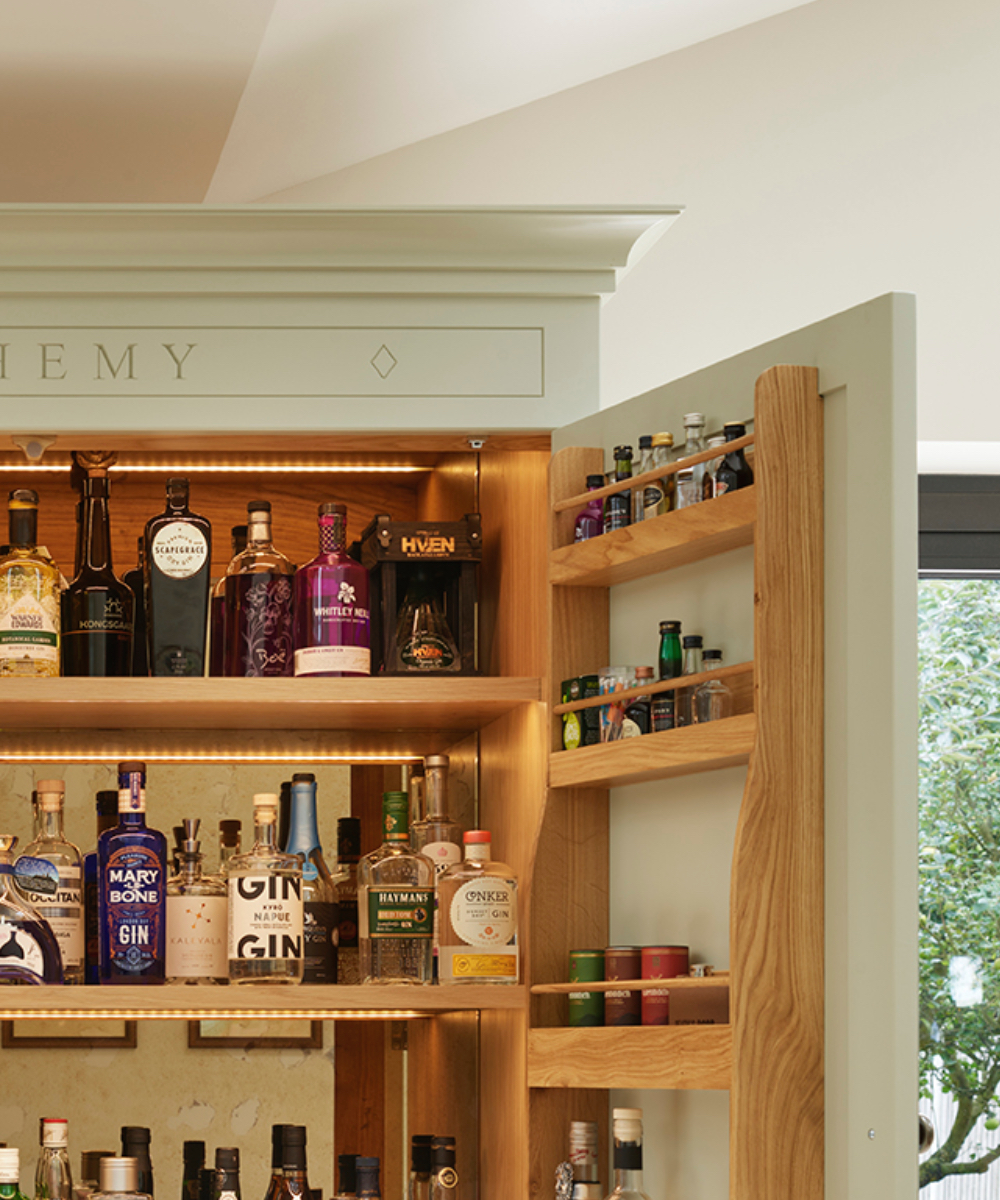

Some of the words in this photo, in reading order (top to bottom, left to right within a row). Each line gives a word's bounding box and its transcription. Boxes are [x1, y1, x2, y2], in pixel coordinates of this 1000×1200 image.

[155, 546, 204, 554] SCAPEGRACE
[314, 606, 352, 617] WHITLEY
[109, 869, 159, 884] MARY
[237, 876, 302, 901] GIN
[110, 890, 158, 903] BONE
[465, 890, 510, 902] CONKER
[254, 912, 291, 922] NAPUE
[491, 909, 510, 918] GIN
[119, 924, 149, 945] GIN
[237, 934, 302, 958] GIN
